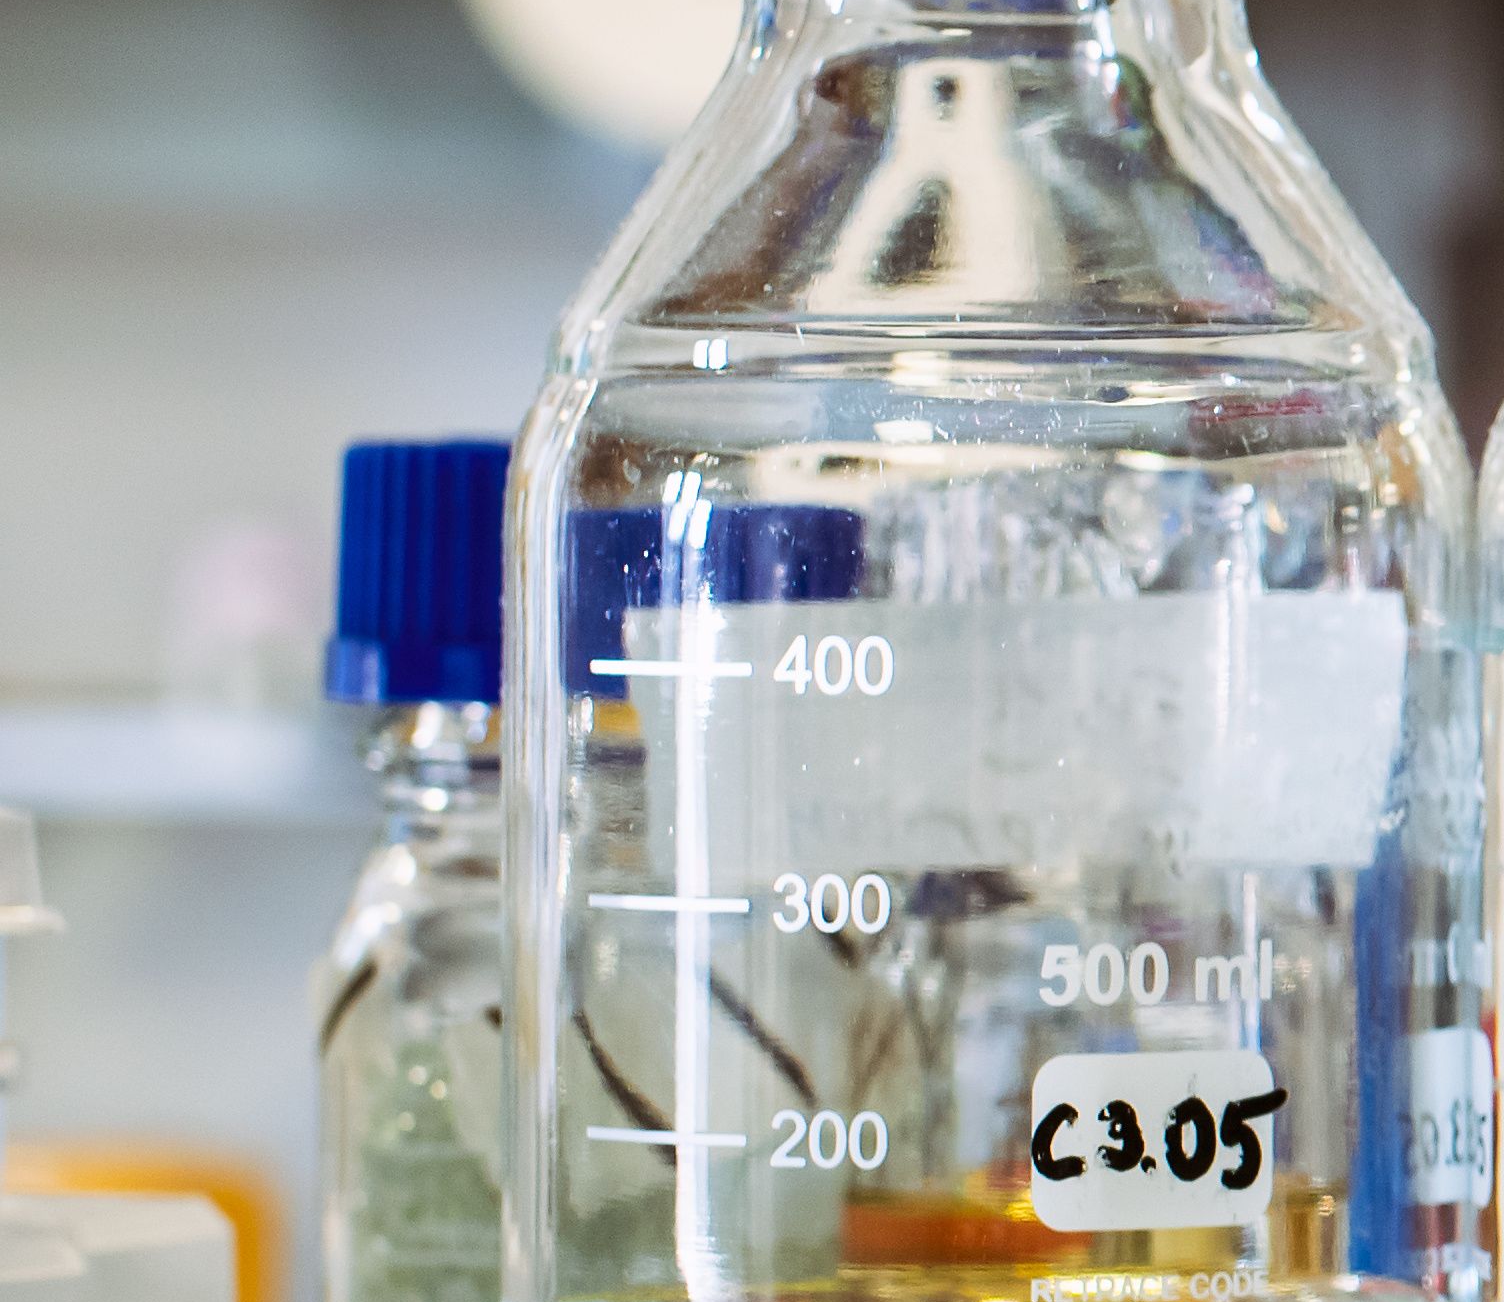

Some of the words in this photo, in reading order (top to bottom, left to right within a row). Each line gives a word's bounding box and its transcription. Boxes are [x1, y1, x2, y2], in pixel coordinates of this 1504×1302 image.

[771, 634, 896, 697] 400
[771, 872, 892, 935] 300
[1038, 941, 1171, 1008] 500
[1194, 937, 1274, 1003] ml
[768, 1108, 890, 1171] 200
[1030, 1087, 1289, 1191] C3.05
[1188, 1269, 1271, 1302] CODE
